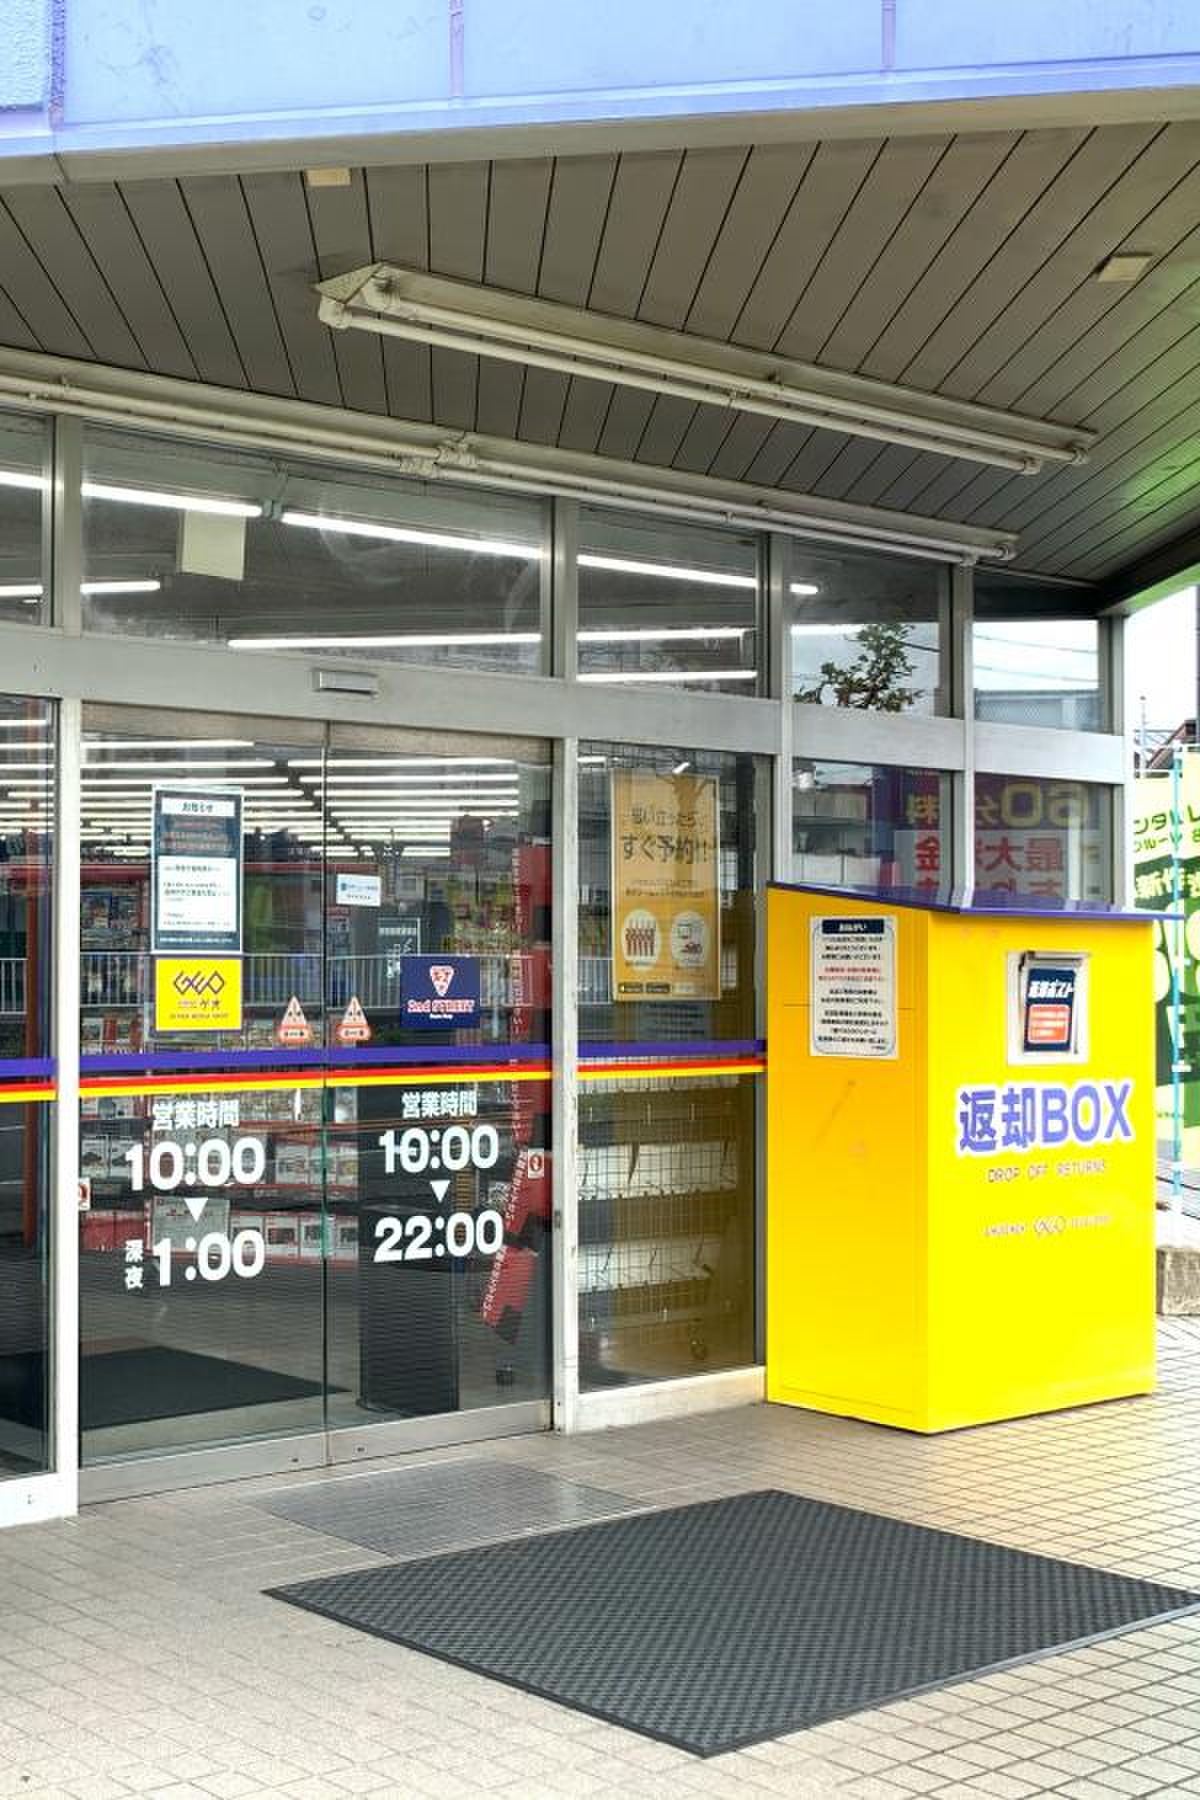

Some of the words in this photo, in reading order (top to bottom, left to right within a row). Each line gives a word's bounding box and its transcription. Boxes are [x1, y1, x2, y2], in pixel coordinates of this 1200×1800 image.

[152, 1099, 240, 1131] 営業時間
[401, 1090, 478, 1119] 営業時間
[960, 1084, 1131, 1151] 返却BOX
[125, 1136, 266, 1192] 10:00
[379, 1124, 499, 1173] 10:00
[152, 1229, 265, 1287] 1:00
[373, 1210, 504, 1263] 22:00
[125, 1238, 144, 1291] 深夜
